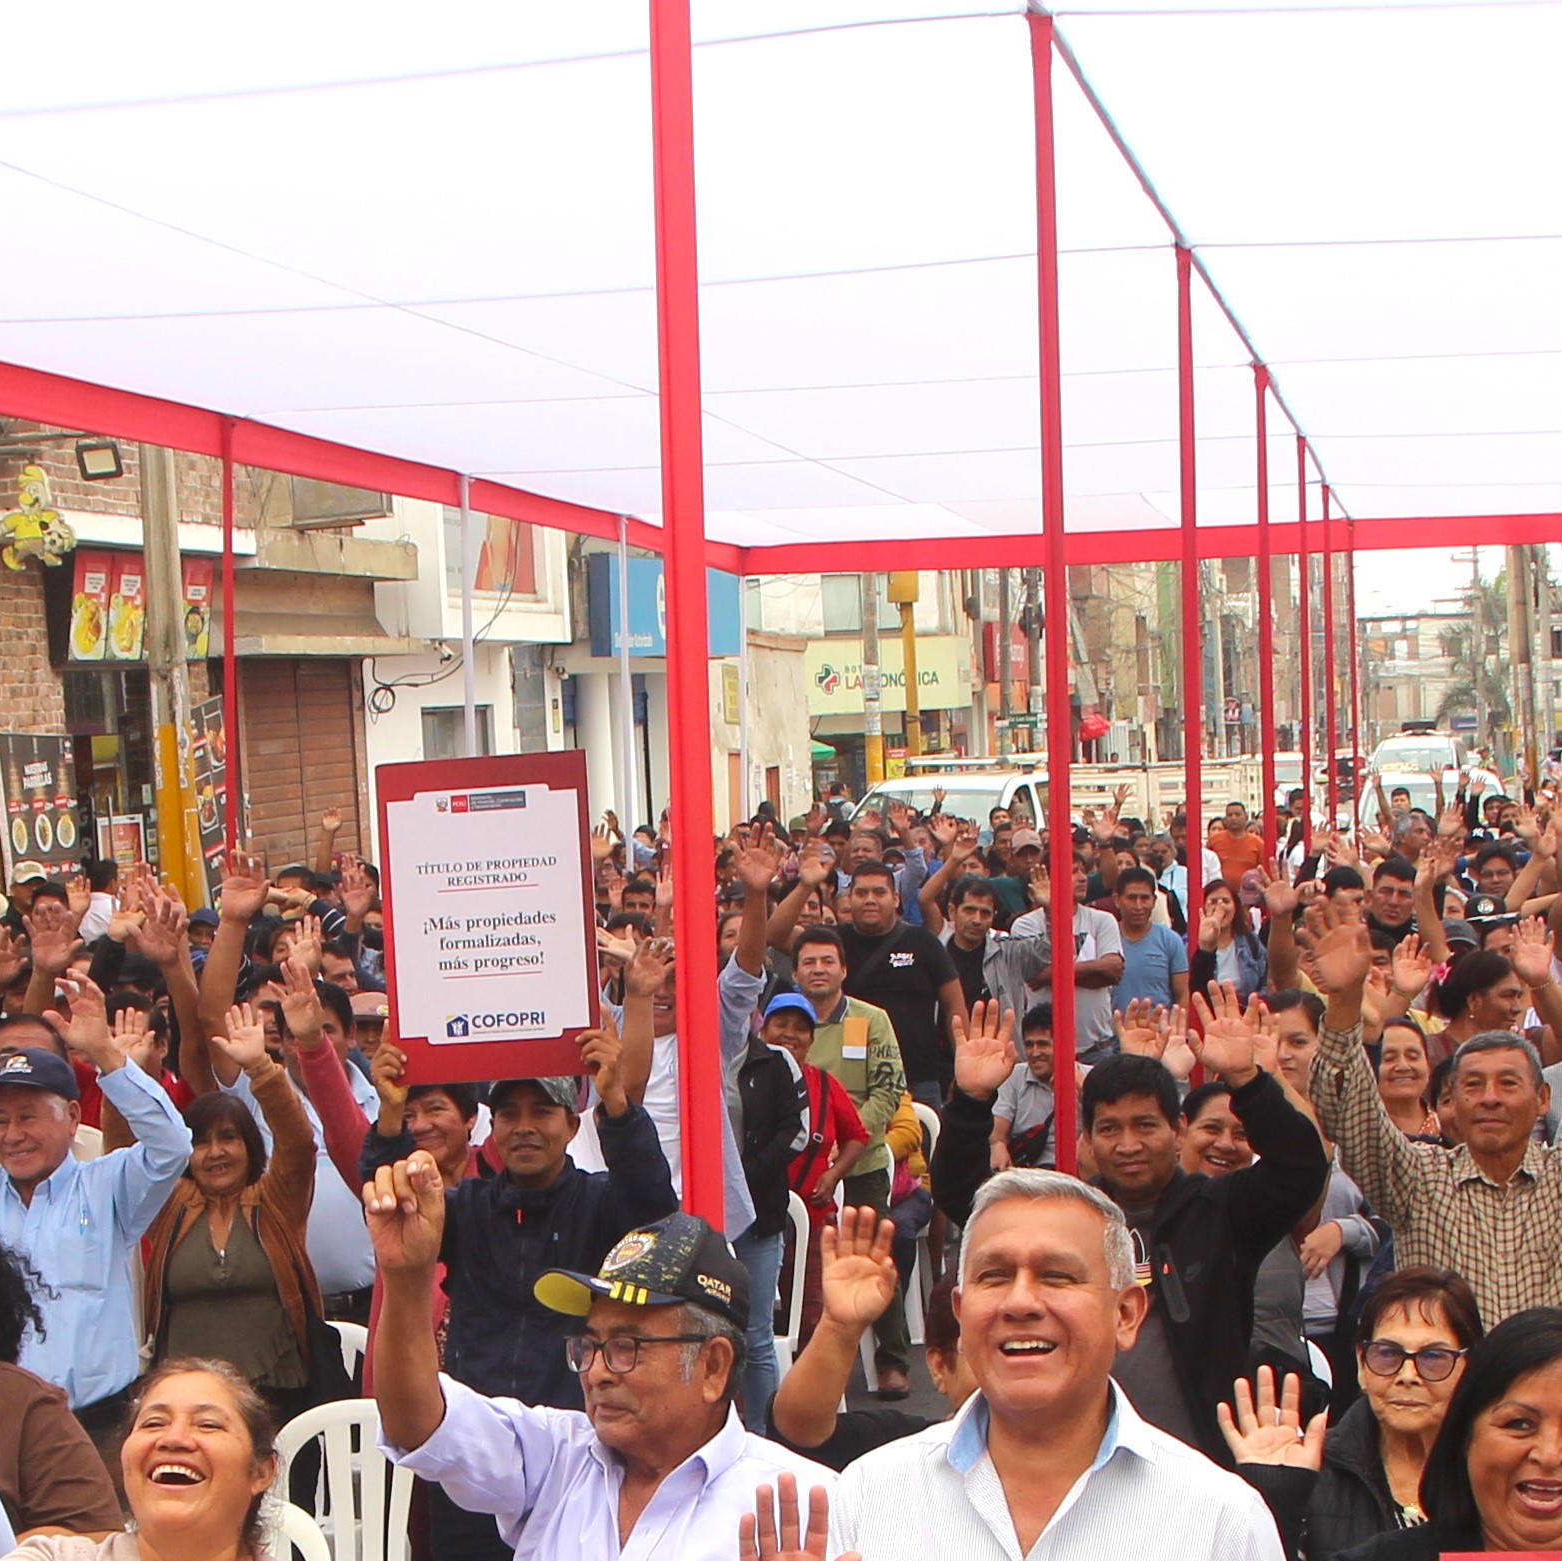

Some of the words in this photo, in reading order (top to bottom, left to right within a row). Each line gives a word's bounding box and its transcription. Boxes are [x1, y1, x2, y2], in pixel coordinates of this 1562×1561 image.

[846, 676, 863, 689] LA
[416, 861, 462, 875] TÍTULO
[466, 860, 483, 872] DE
[486, 856, 557, 870] PROPIEDAD
[447, 873, 527, 886] REGISTRADO
[423, 915, 461, 935] ¡Más
[466, 911, 556, 932] propiedades
[439, 932, 541, 951] formalizadas,
[439, 956, 469, 970] más
[474, 952, 544, 971] progreso!
[472, 1011, 545, 1028] COFOPRI
[697, 1274, 732, 1296] QATAR
